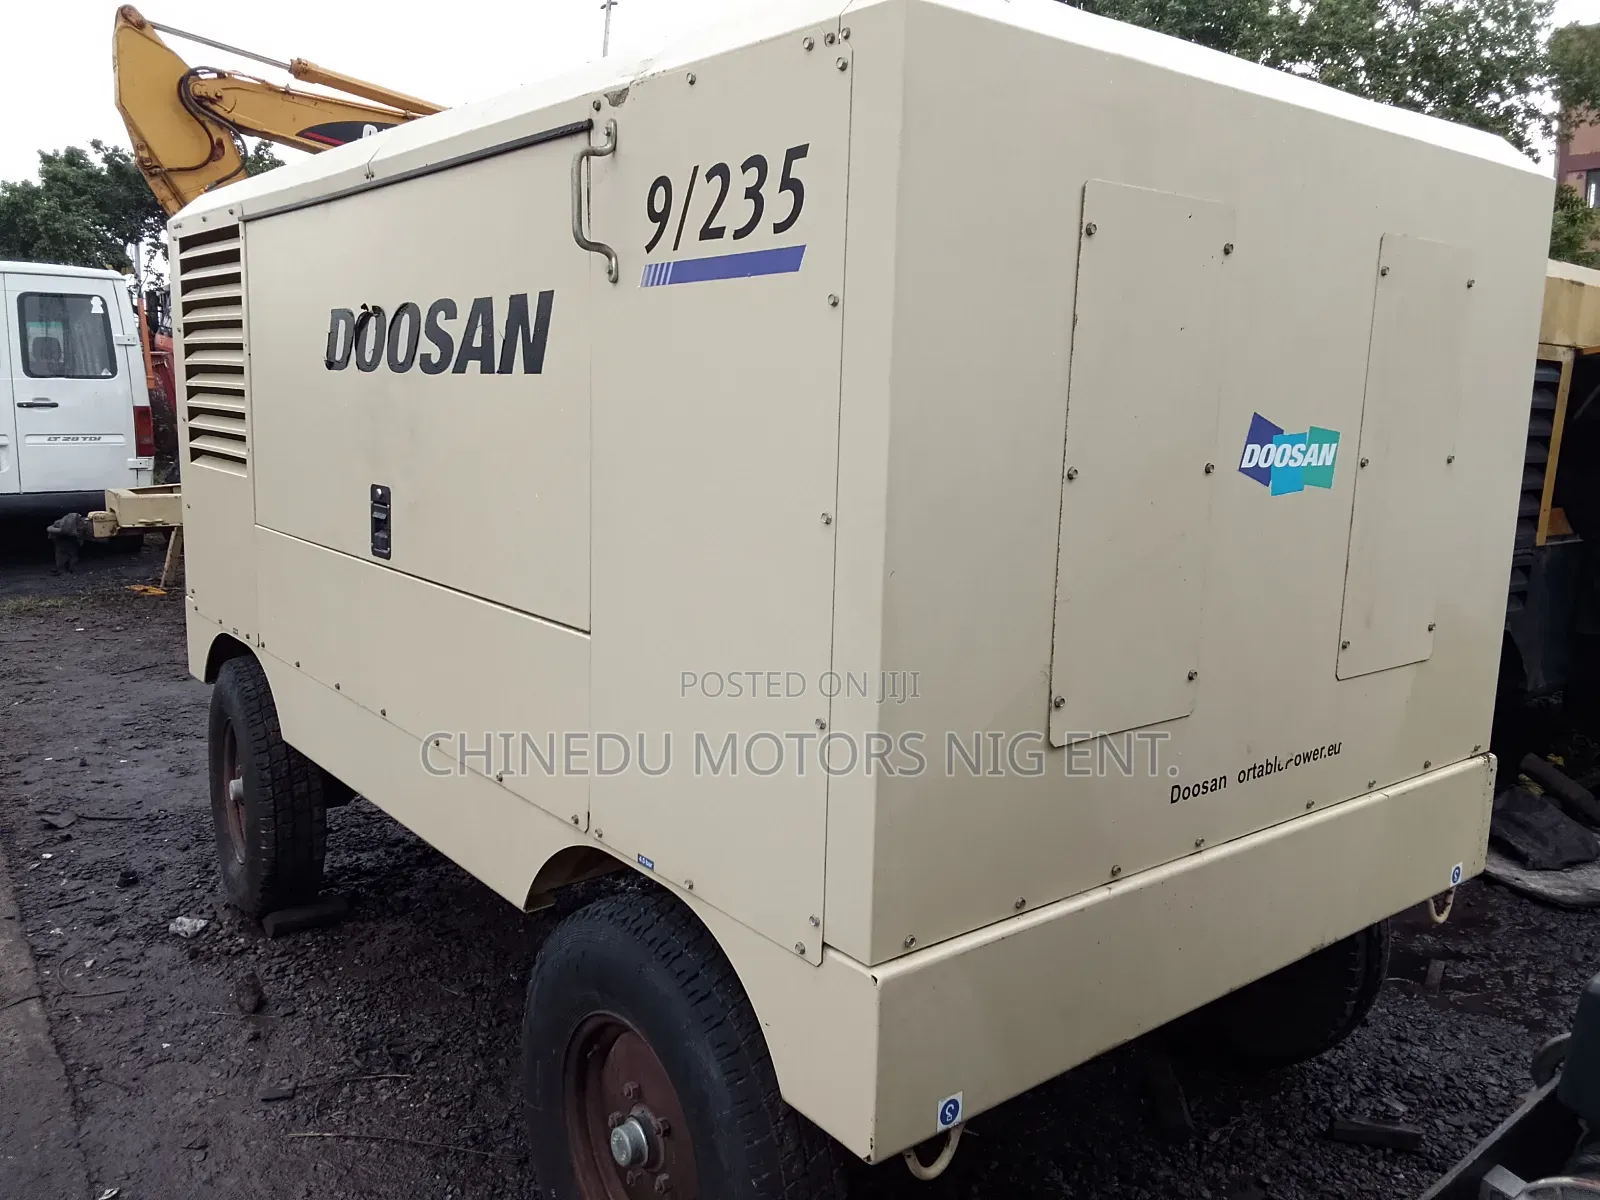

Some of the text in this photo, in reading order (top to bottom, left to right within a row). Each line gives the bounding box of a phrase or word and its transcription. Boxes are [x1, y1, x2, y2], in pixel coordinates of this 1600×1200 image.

[645, 143, 810, 254] 9/235
[324, 289, 554, 375] DOOSAN
[1241, 443, 1337, 468] DOOSAN
